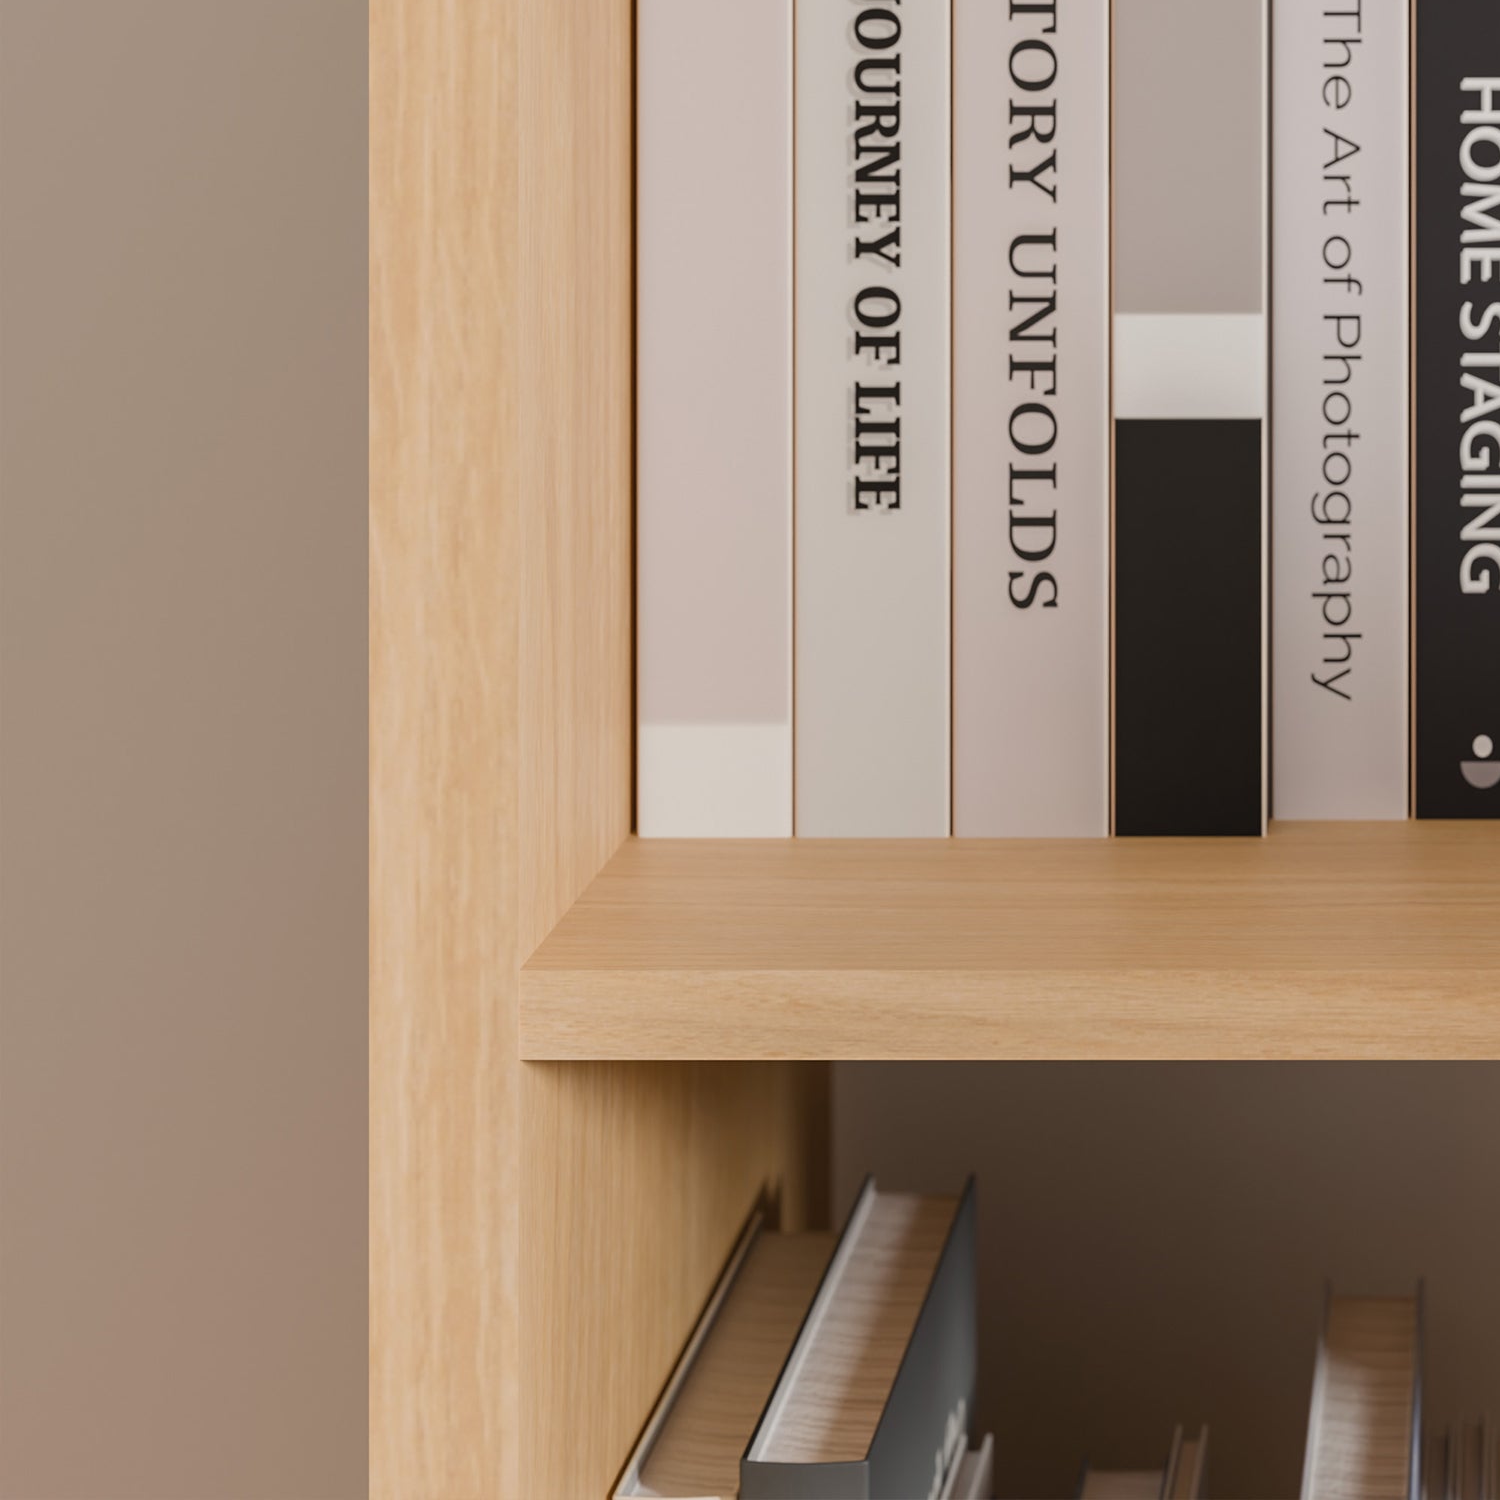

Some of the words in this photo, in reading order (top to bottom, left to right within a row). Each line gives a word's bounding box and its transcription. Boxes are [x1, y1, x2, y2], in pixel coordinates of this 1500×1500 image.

[1321, 127, 1363, 216] Art
[1321, 235, 1364, 296] of
[852, 285, 903, 367] OF
[852, 380, 903, 512] LIFE
[1008, 226, 1059, 610] UNFOLDS
[1310, 313, 1363, 702] Photography
